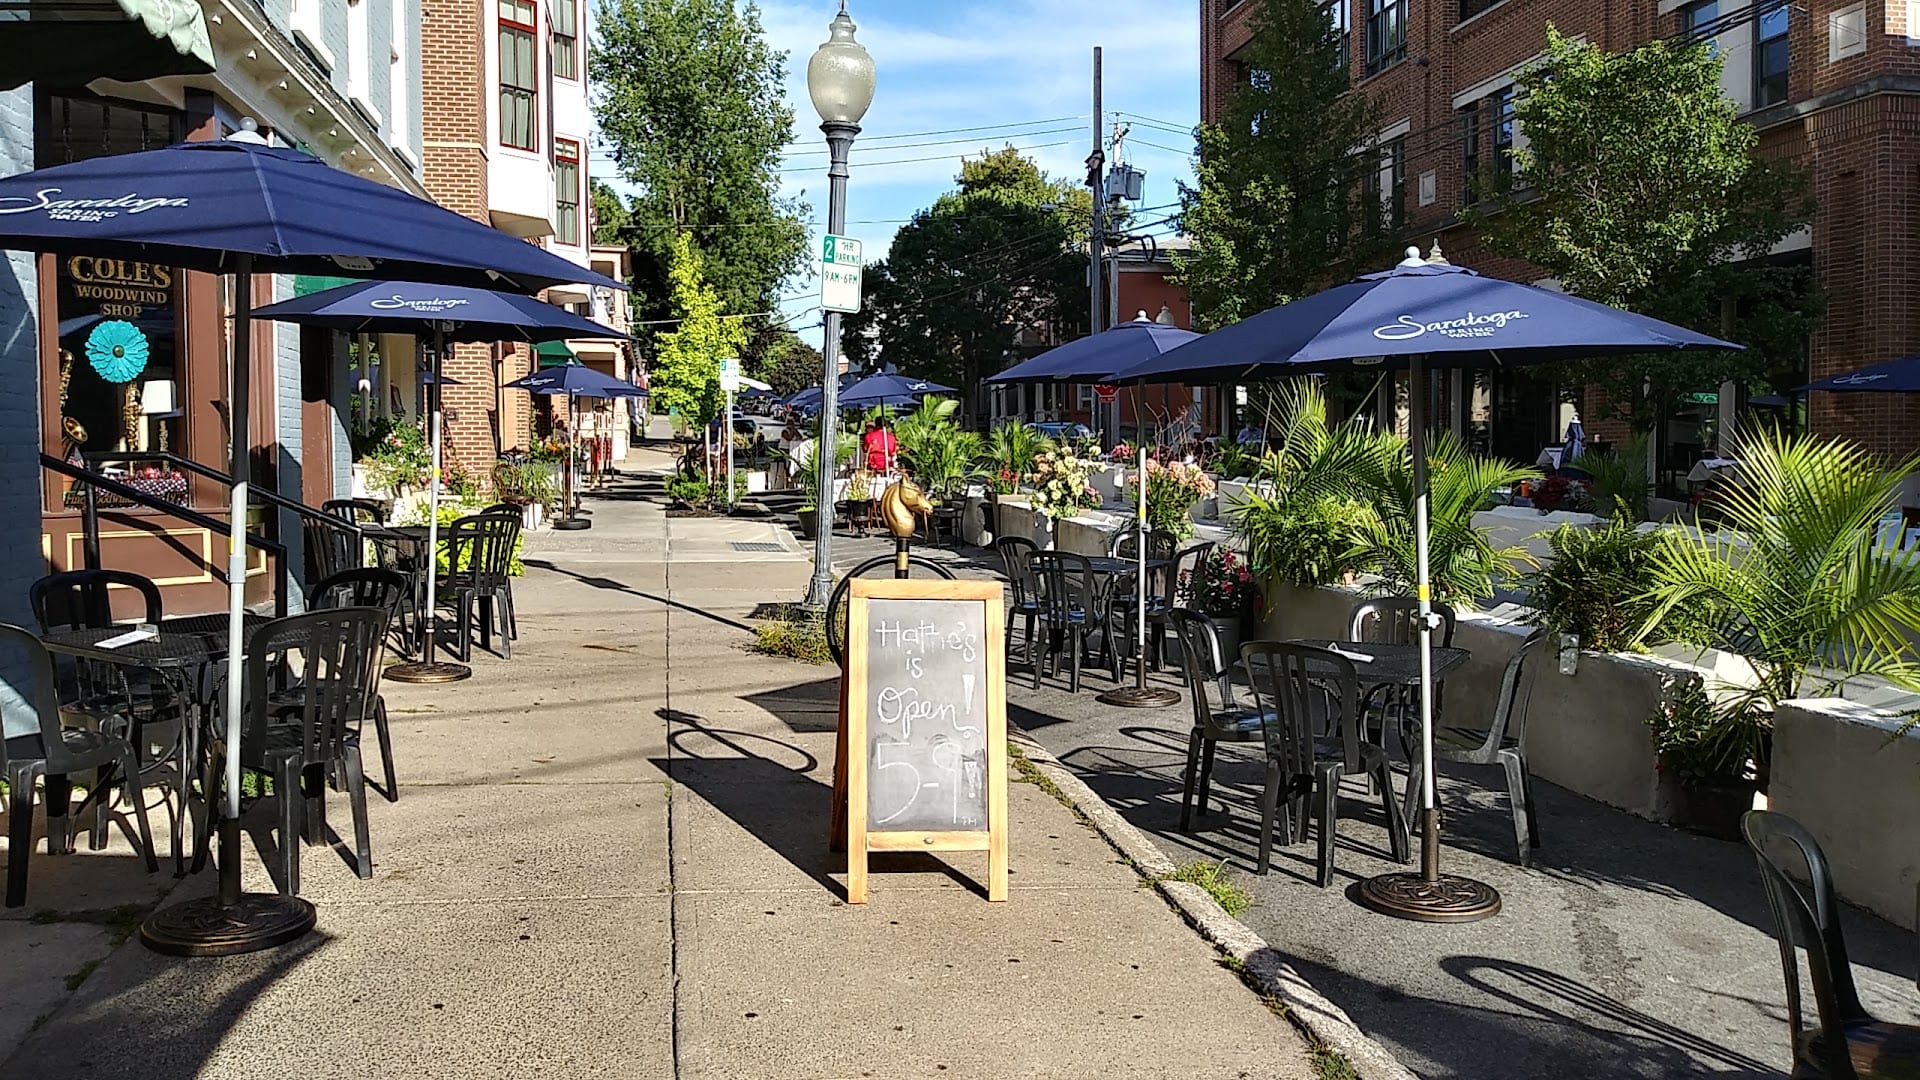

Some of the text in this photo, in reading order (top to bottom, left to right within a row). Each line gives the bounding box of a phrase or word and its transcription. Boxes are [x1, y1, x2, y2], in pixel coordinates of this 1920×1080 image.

[0, 188, 190, 214] Saratoga
[48, 208, 119, 218] SPRING
[49, 213, 103, 223] WATER
[825, 240, 833, 259] 2
[75, 285, 168, 305] WOODWIND
[371, 295, 471, 309] Saratoga
[101, 303, 143, 318] SHOP
[1373, 310, 1530, 340] Saratoga
[1440, 326, 1496, 335] SPRING
[905, 649, 924, 679] is
